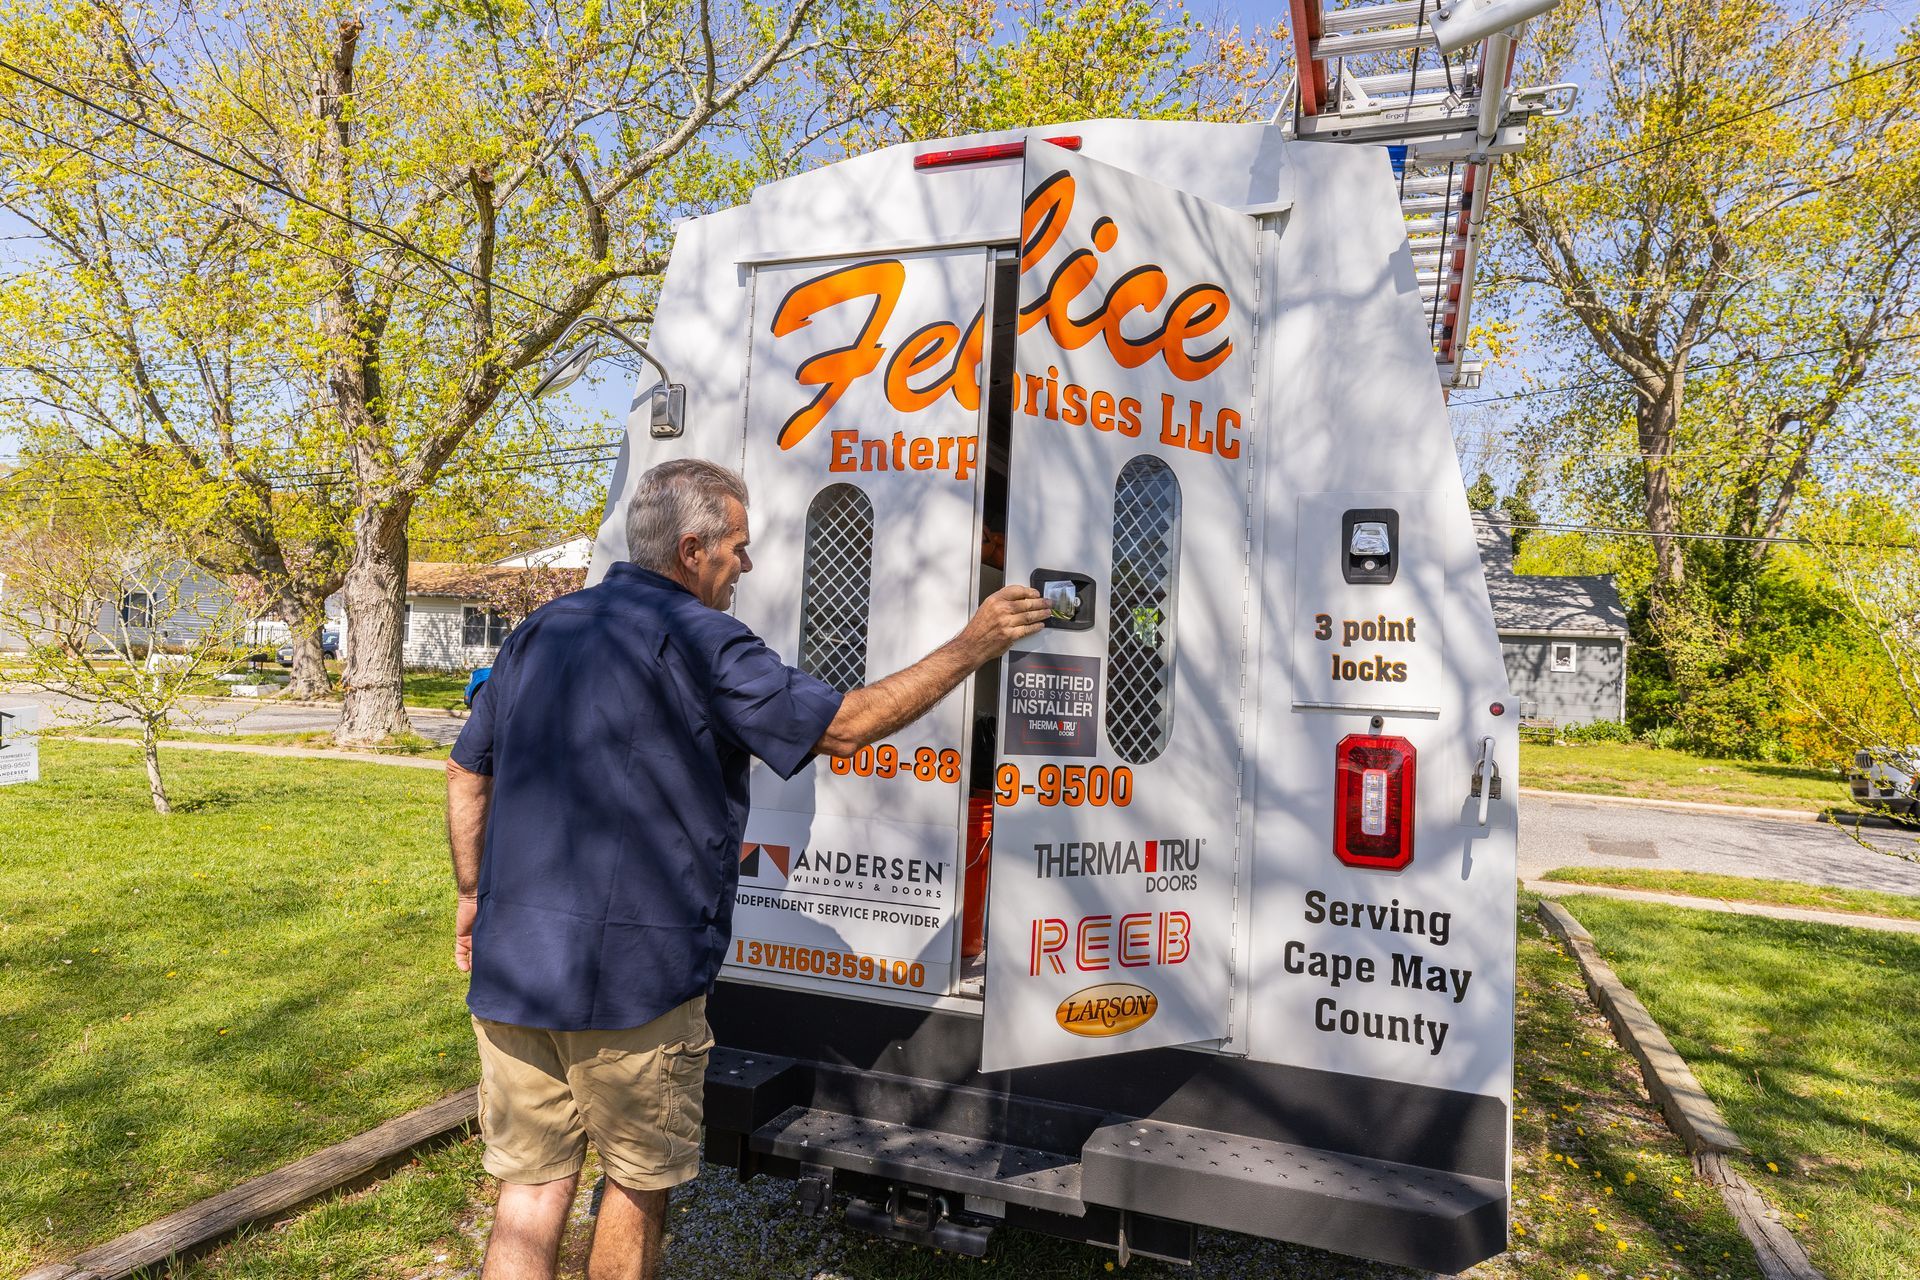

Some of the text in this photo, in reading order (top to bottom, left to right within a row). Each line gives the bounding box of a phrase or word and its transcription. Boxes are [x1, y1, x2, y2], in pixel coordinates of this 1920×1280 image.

[828, 365, 1241, 480] Enterp rises LLC
[1314, 613, 1416, 647] 3 point
[1013, 672, 1094, 691] CERTIFIED
[1331, 653, 1408, 683] locks
[1012, 688, 1093, 702] DOOR SYSTEM
[1012, 699, 1093, 717] INSTALLER
[1029, 720, 1058, 730] THERMA
[994, 763, 1133, 807] 9-9500
[1033, 841, 1142, 878] THERMA
[793, 874, 942, 899] WINDOWS & DOORS
[1146, 874, 1198, 893] DOORS
[817, 902, 869, 920] SERVICE
[872, 909, 940, 929] PROVIDER
[1304, 889, 1451, 946] Serving
[1030, 911, 1191, 976] REEB
[736, 939, 925, 987] 13VH60359100
[1283, 940, 1473, 1004] Cape May
[1064, 995, 1152, 1028] LARSON
[1315, 997, 1449, 1056] County
